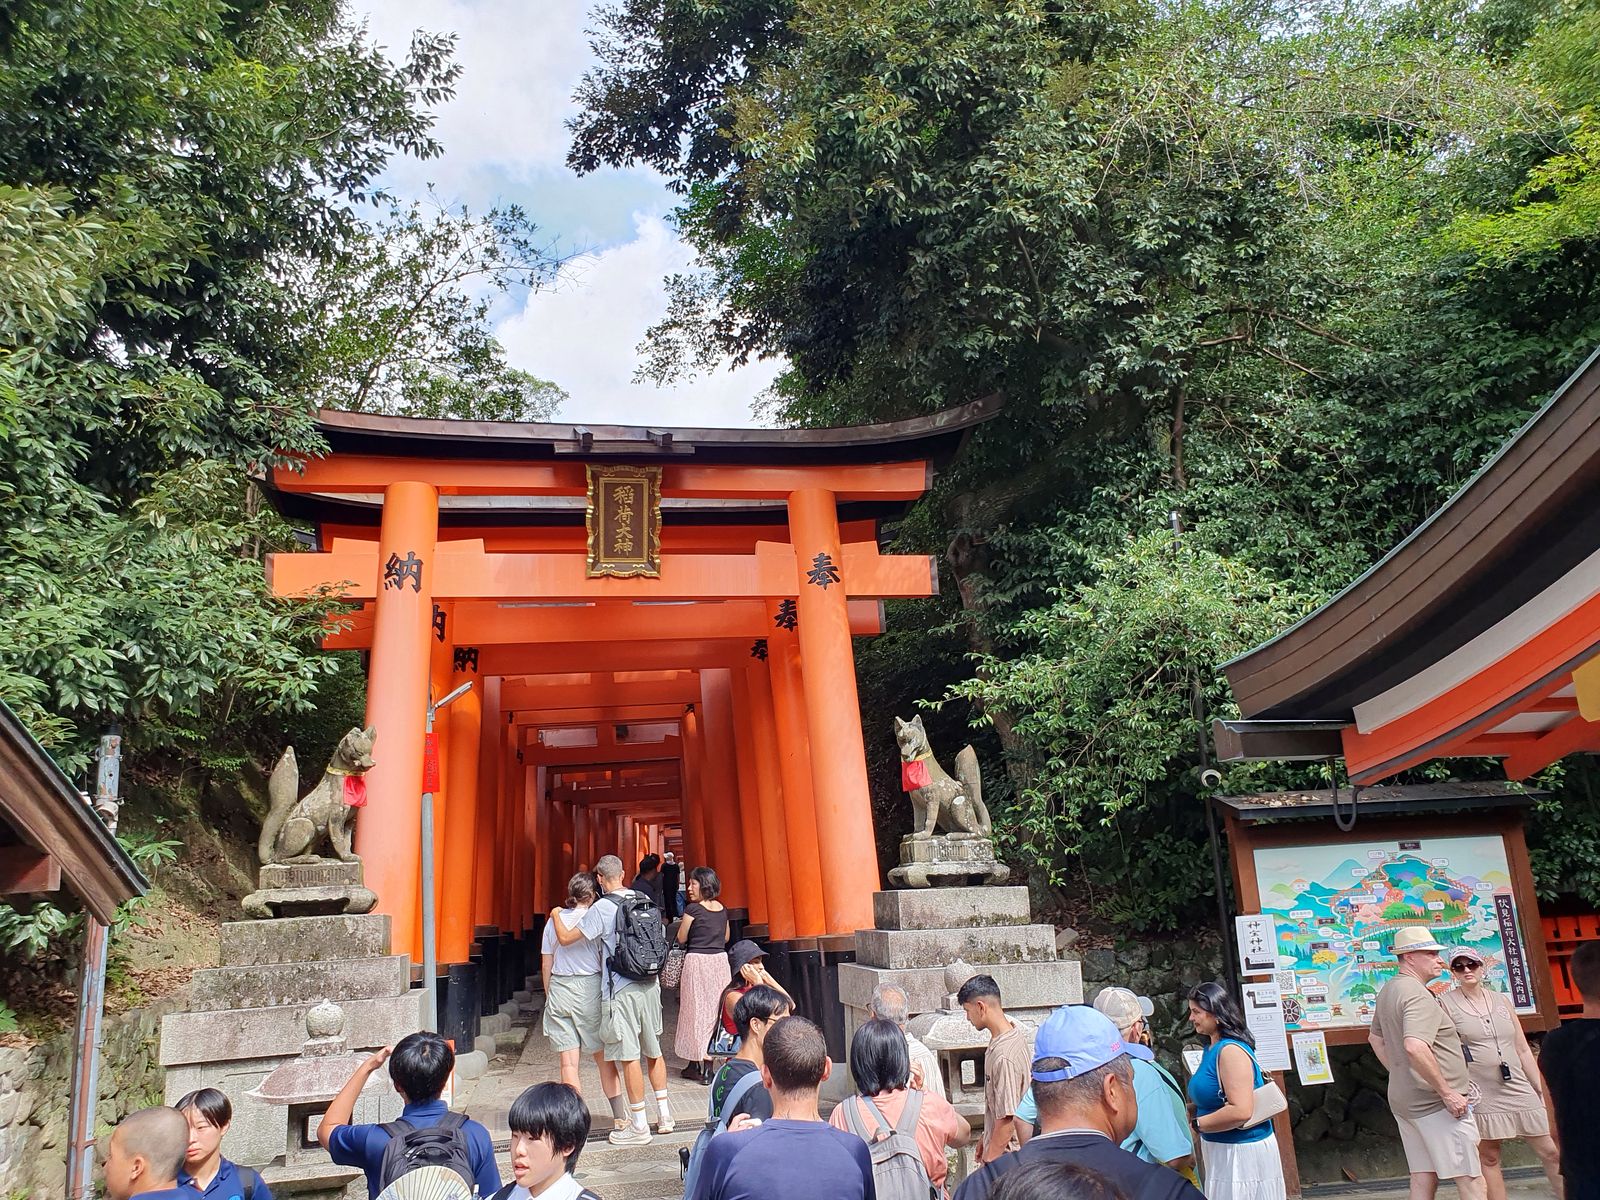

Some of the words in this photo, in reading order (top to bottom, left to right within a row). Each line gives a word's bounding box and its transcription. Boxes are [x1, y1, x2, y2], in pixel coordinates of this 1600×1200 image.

[612, 485, 635, 557] 稲荷大神
[383, 551, 425, 593] 納
[806, 552, 841, 591] 奉
[773, 599, 798, 633] 奉
